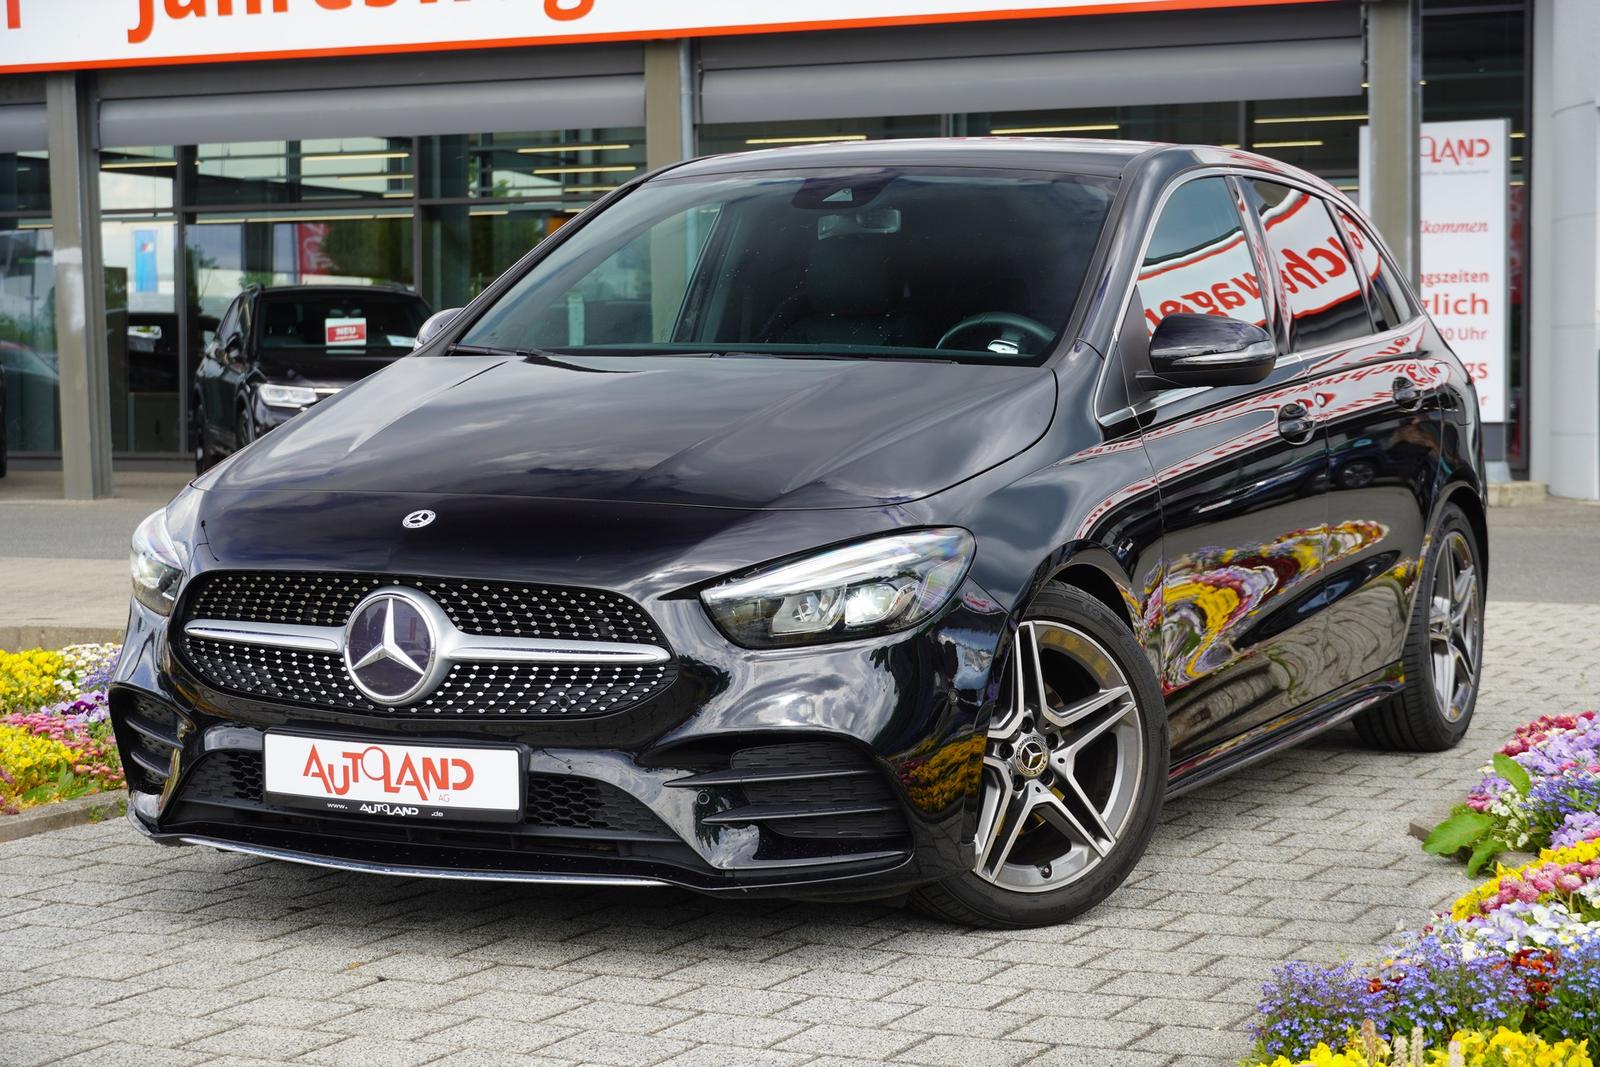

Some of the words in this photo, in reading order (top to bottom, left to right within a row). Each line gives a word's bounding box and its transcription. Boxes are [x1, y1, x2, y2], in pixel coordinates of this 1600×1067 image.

[1458, 326, 1487, 340] Uhr
[303, 743, 474, 800] AUTOLAND
[438, 794, 450, 803] AG
[327, 802, 348, 810] www.
[360, 803, 419, 816] AUTOLAND
